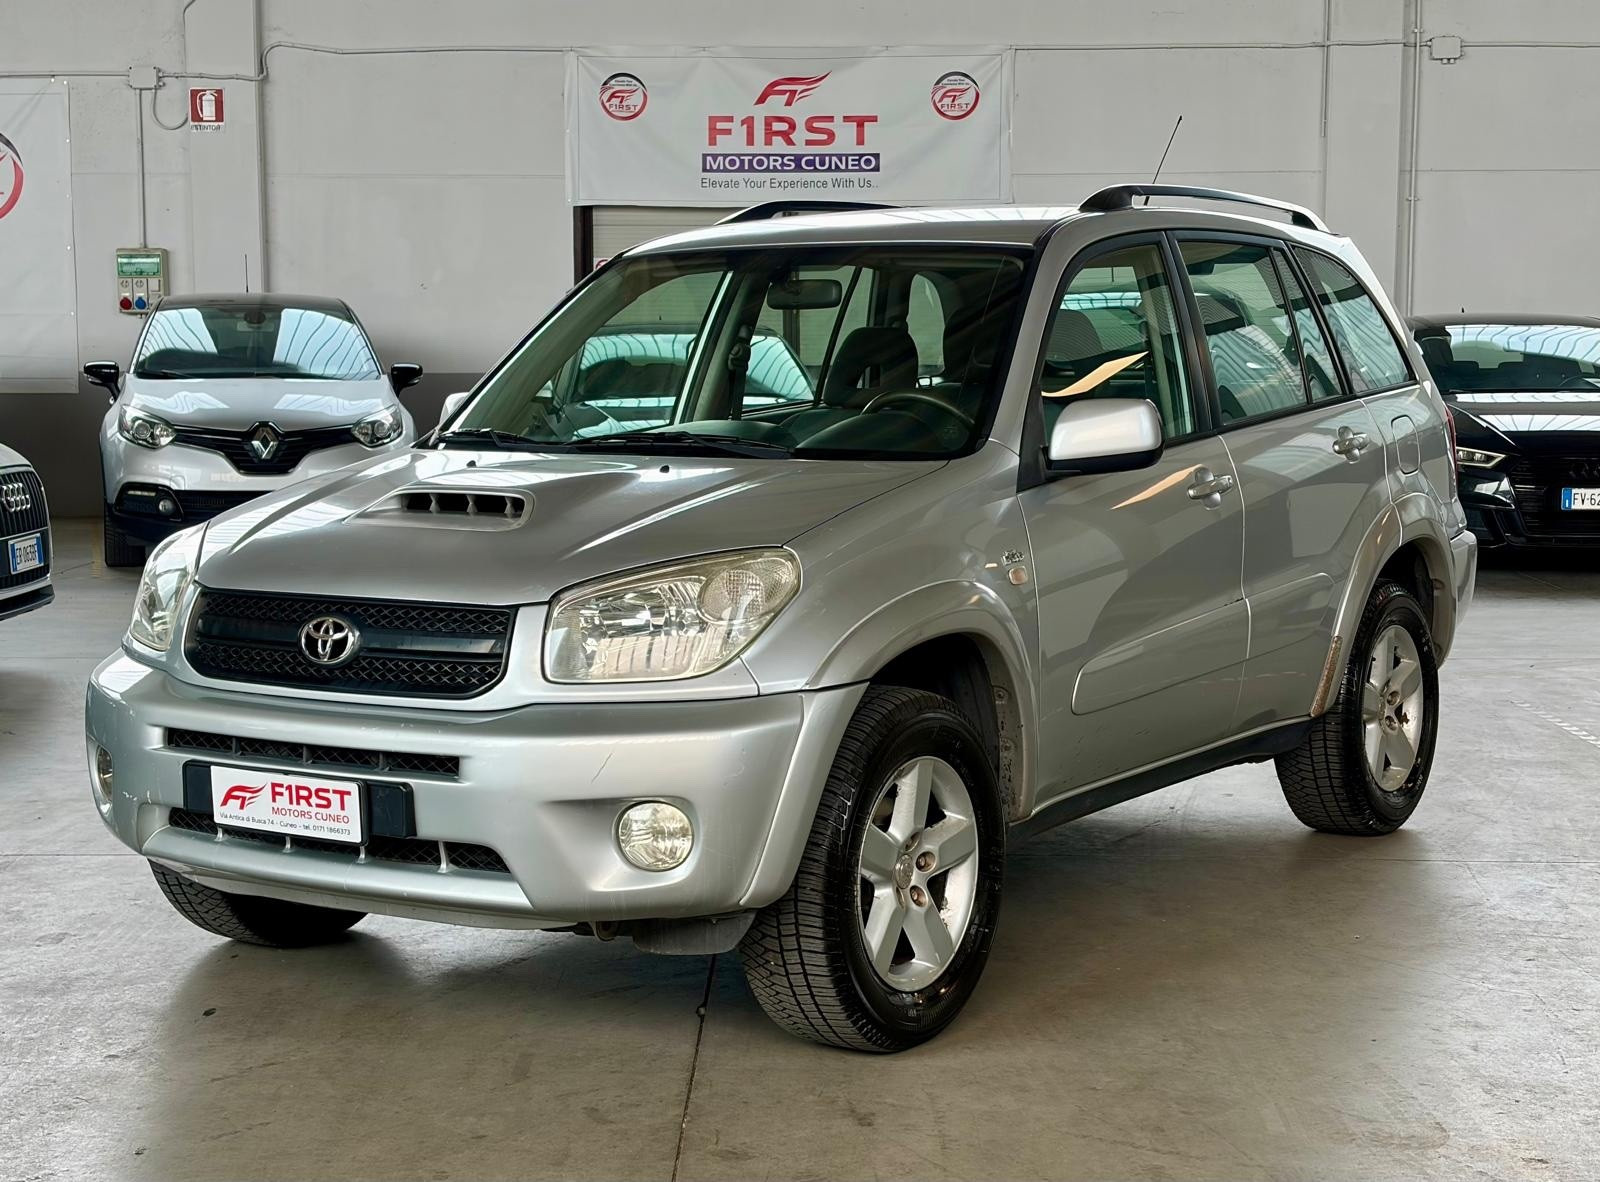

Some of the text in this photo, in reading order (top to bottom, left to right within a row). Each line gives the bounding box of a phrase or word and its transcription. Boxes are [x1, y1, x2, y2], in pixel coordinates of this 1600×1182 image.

[707, 115, 878, 147] F1RST
[706, 155, 876, 170] MOTORS CUNEO
[701, 178, 740, 189] Elevate
[742, 178, 767, 189] Your
[769, 178, 828, 191] Experience
[831, 177, 855, 188] With
[271, 782, 352, 811] F1RST
[220, 811, 228, 819] Via
[251, 816, 267, 825] Busca
[279, 820, 297, 829] Cuneo
[312, 824, 326, 832] 0171
[272, 806, 350, 824] MOTORS CUNEO
